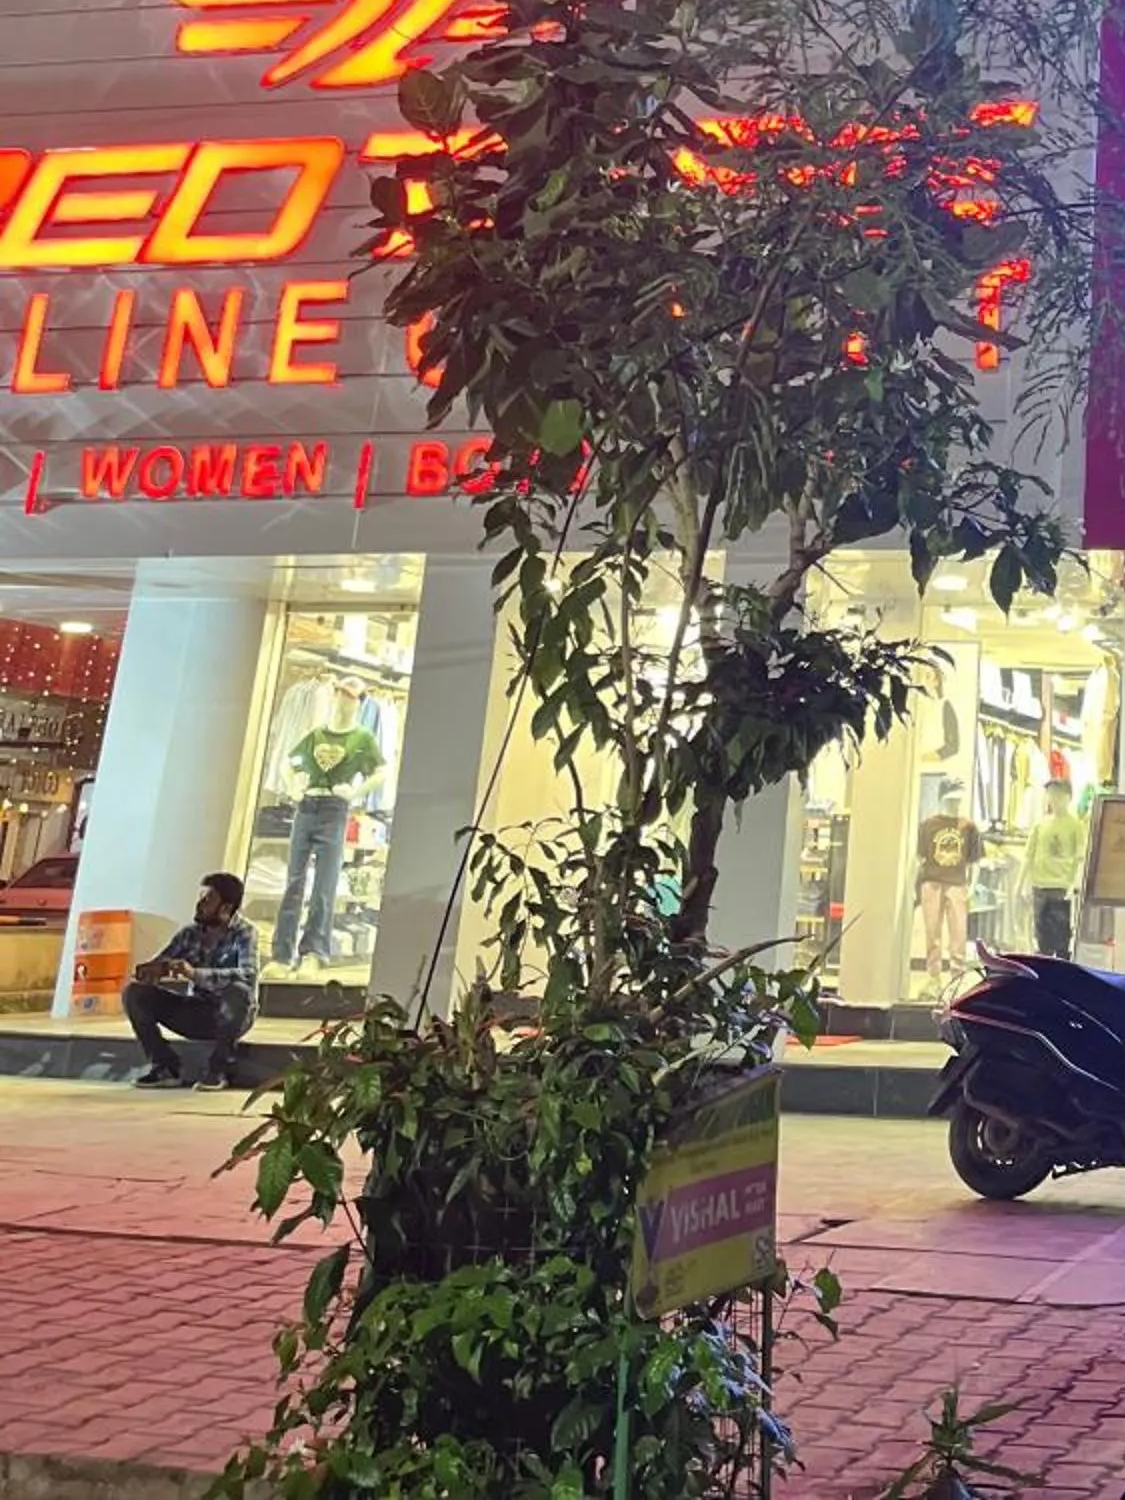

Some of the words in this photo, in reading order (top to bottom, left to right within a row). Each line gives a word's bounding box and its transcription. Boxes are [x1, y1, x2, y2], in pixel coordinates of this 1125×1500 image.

[0, 136, 345, 266] ED
[11, 280, 350, 393] LINE
[80, 440, 328, 498] WOMEN
[669, 1187, 741, 1244] VISHAL
